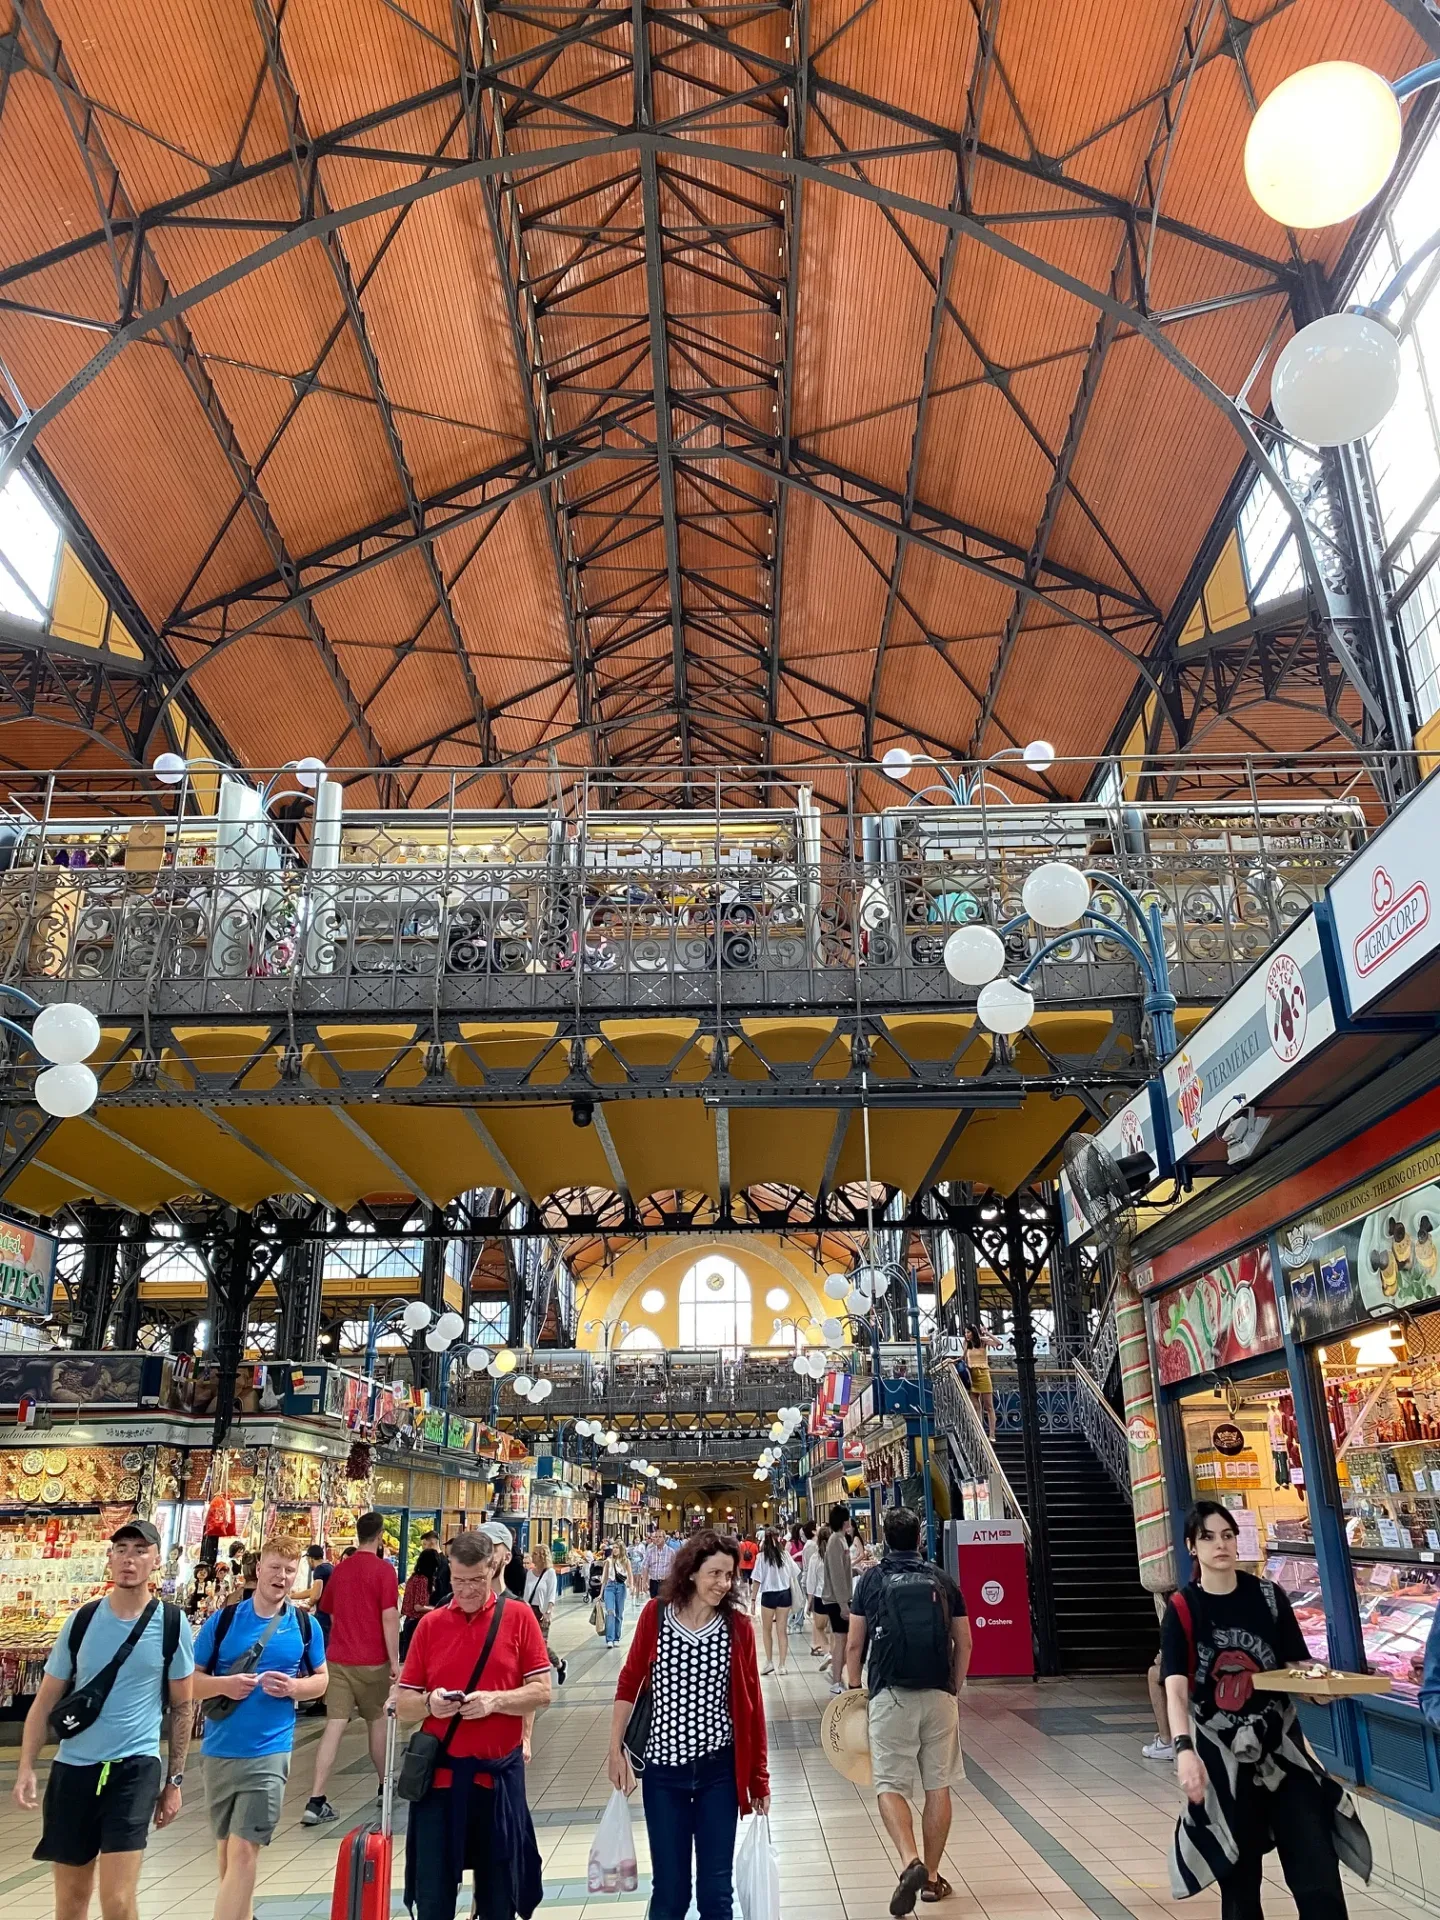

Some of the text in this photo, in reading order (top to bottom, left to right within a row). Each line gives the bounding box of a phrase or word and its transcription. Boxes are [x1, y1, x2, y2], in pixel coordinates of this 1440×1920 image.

[1363, 897, 1418, 966] AGROCORP
[1206, 1030, 1261, 1093] TERMÉKEI
[1312, 1215, 1324, 1228] THE
[1323, 1206, 1341, 1224] FOOD
[1341, 1201, 1350, 1213] OF
[1349, 1190, 1370, 1209] KINGS
[1372, 1180, 1389, 1197] THE
[1388, 1171, 1406, 1190] KING
[1407, 1164, 1418, 1179] OF
[972, 1530, 998, 1542] ATM
